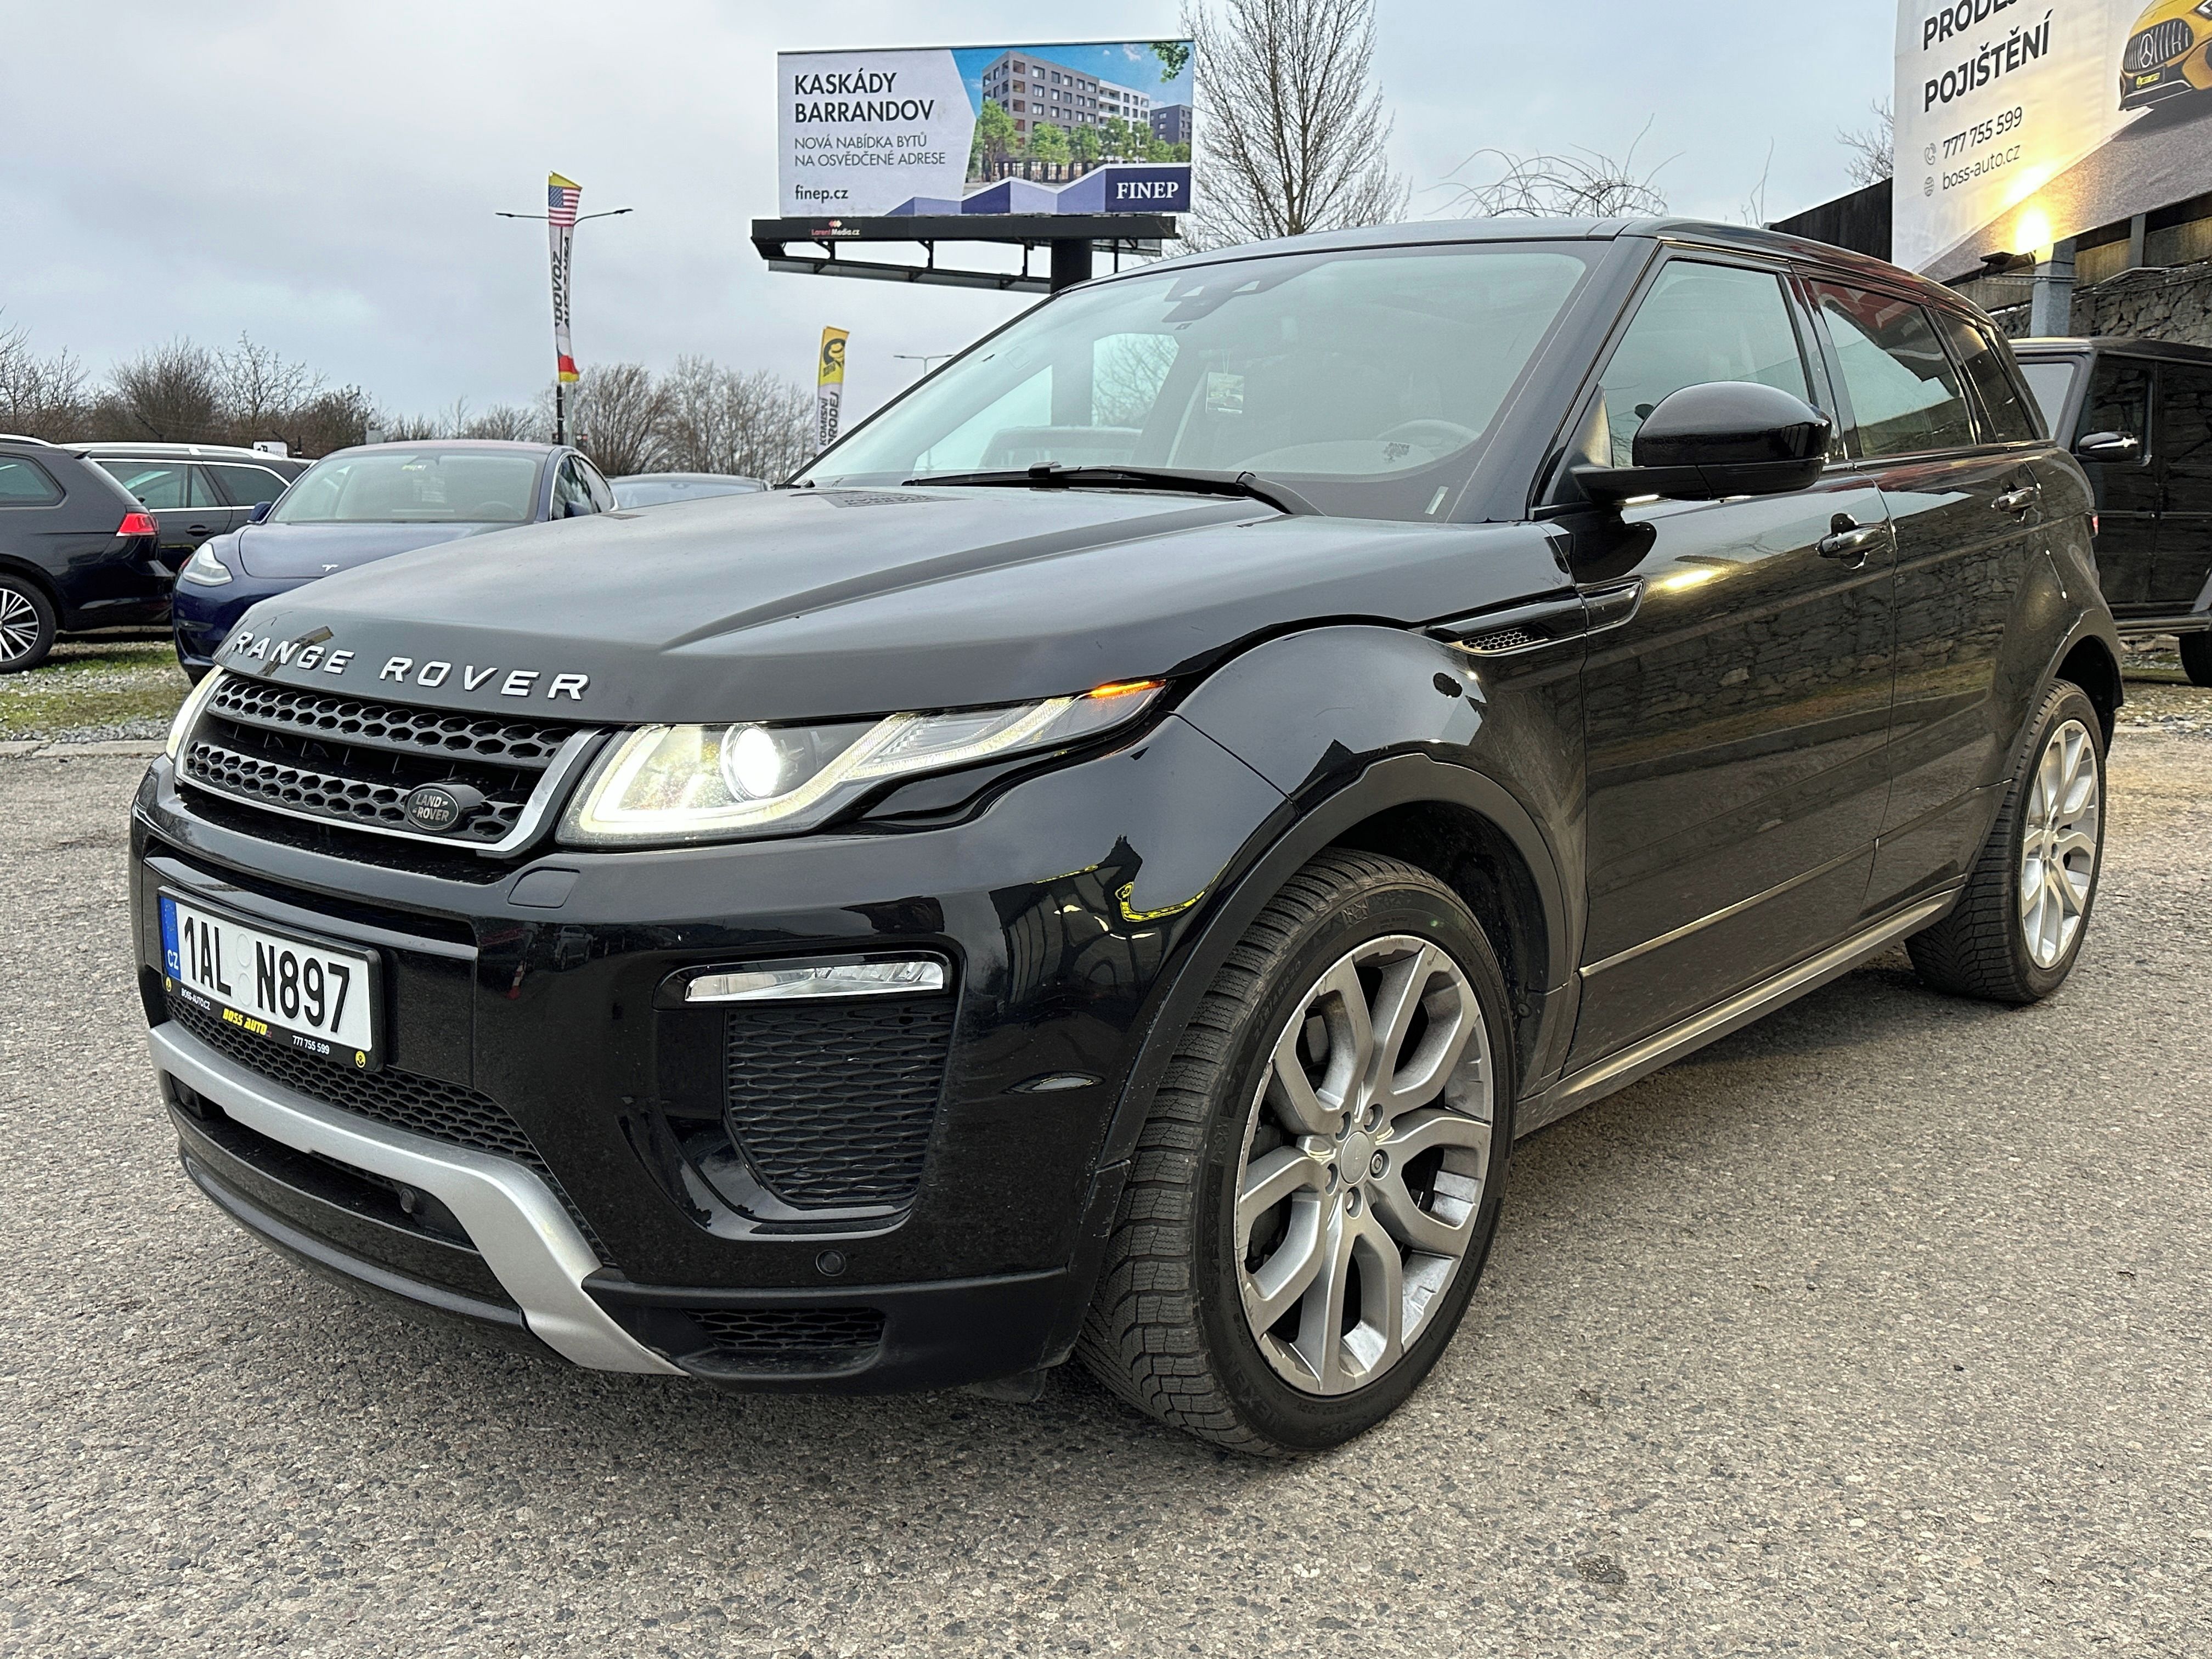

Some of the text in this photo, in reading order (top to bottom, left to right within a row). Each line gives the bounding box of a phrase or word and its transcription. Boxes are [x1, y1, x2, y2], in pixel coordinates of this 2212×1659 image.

[1923, 0, 2017, 50] PROD
[1924, 9, 2053, 113] POJIŠTĚNÍ
[795, 67, 898, 94] KASKÁDY
[795, 100, 935, 123] BARRANDOV
[795, 131, 927, 149] NOVÁ NABÍDKA BYTŮ
[1943, 106, 2022, 159] 777 755 599
[795, 150, 946, 166] NA OSVĚDČENÉ ADRESE
[1943, 145, 2021, 190] boss-auto.cz
[795, 184, 849, 204] finep.cz
[1116, 182, 1179, 199] FINEP
[552, 251, 563, 321] DOVOZ
[232, 631, 590, 701] RANGE ROVER
[416, 793, 442, 808] LAND
[416, 806, 449, 822] ROVER
[167, 950, 179, 970] CZ
[184, 916, 350, 1034] 1AL N897
[182, 988, 211, 1011] BOSS-AUTO.CZ
[222, 1008, 244, 1026] BOSS
[244, 1018, 268, 1036] AUTO
[292, 1035, 330, 1054] 777 755 599
